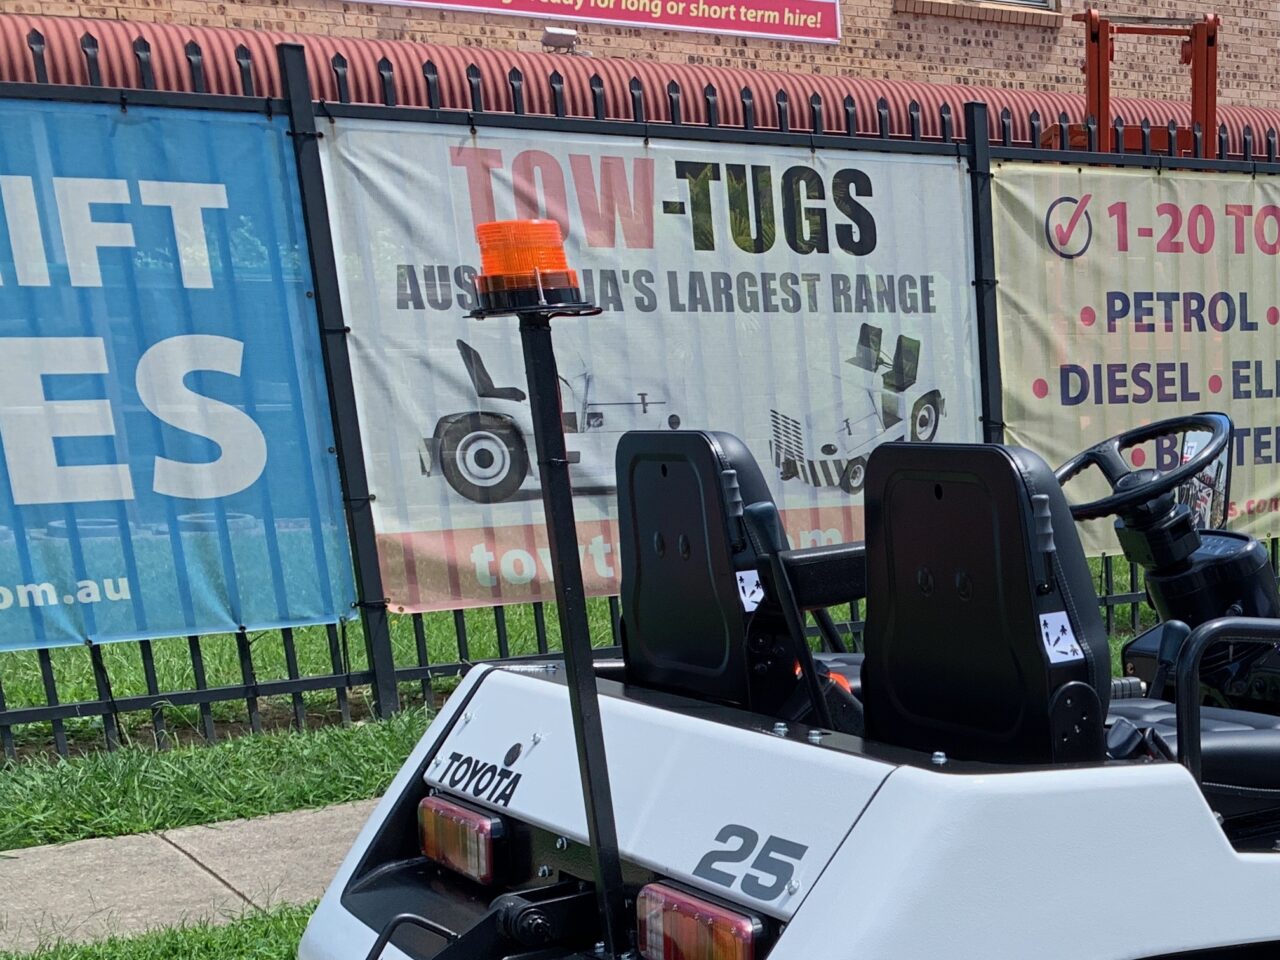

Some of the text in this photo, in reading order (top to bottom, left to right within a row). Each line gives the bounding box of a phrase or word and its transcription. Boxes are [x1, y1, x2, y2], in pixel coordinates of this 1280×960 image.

[666, 1, 687, 15] or
[689, 0, 736, 20] short
[740, 6, 780, 24] term
[783, 8, 822, 28] hire!
[0, 175, 229, 288] IFT
[1108, 202, 1216, 254] 1-20
[396, 264, 937, 314] AUSIA'S LARGEST RANGE
[1106, 291, 1259, 333] PETROL
[1060, 362, 1200, 406] DIESEL
[438, 751, 522, 808] TOYOTA
[692, 824, 809, 902] 25
